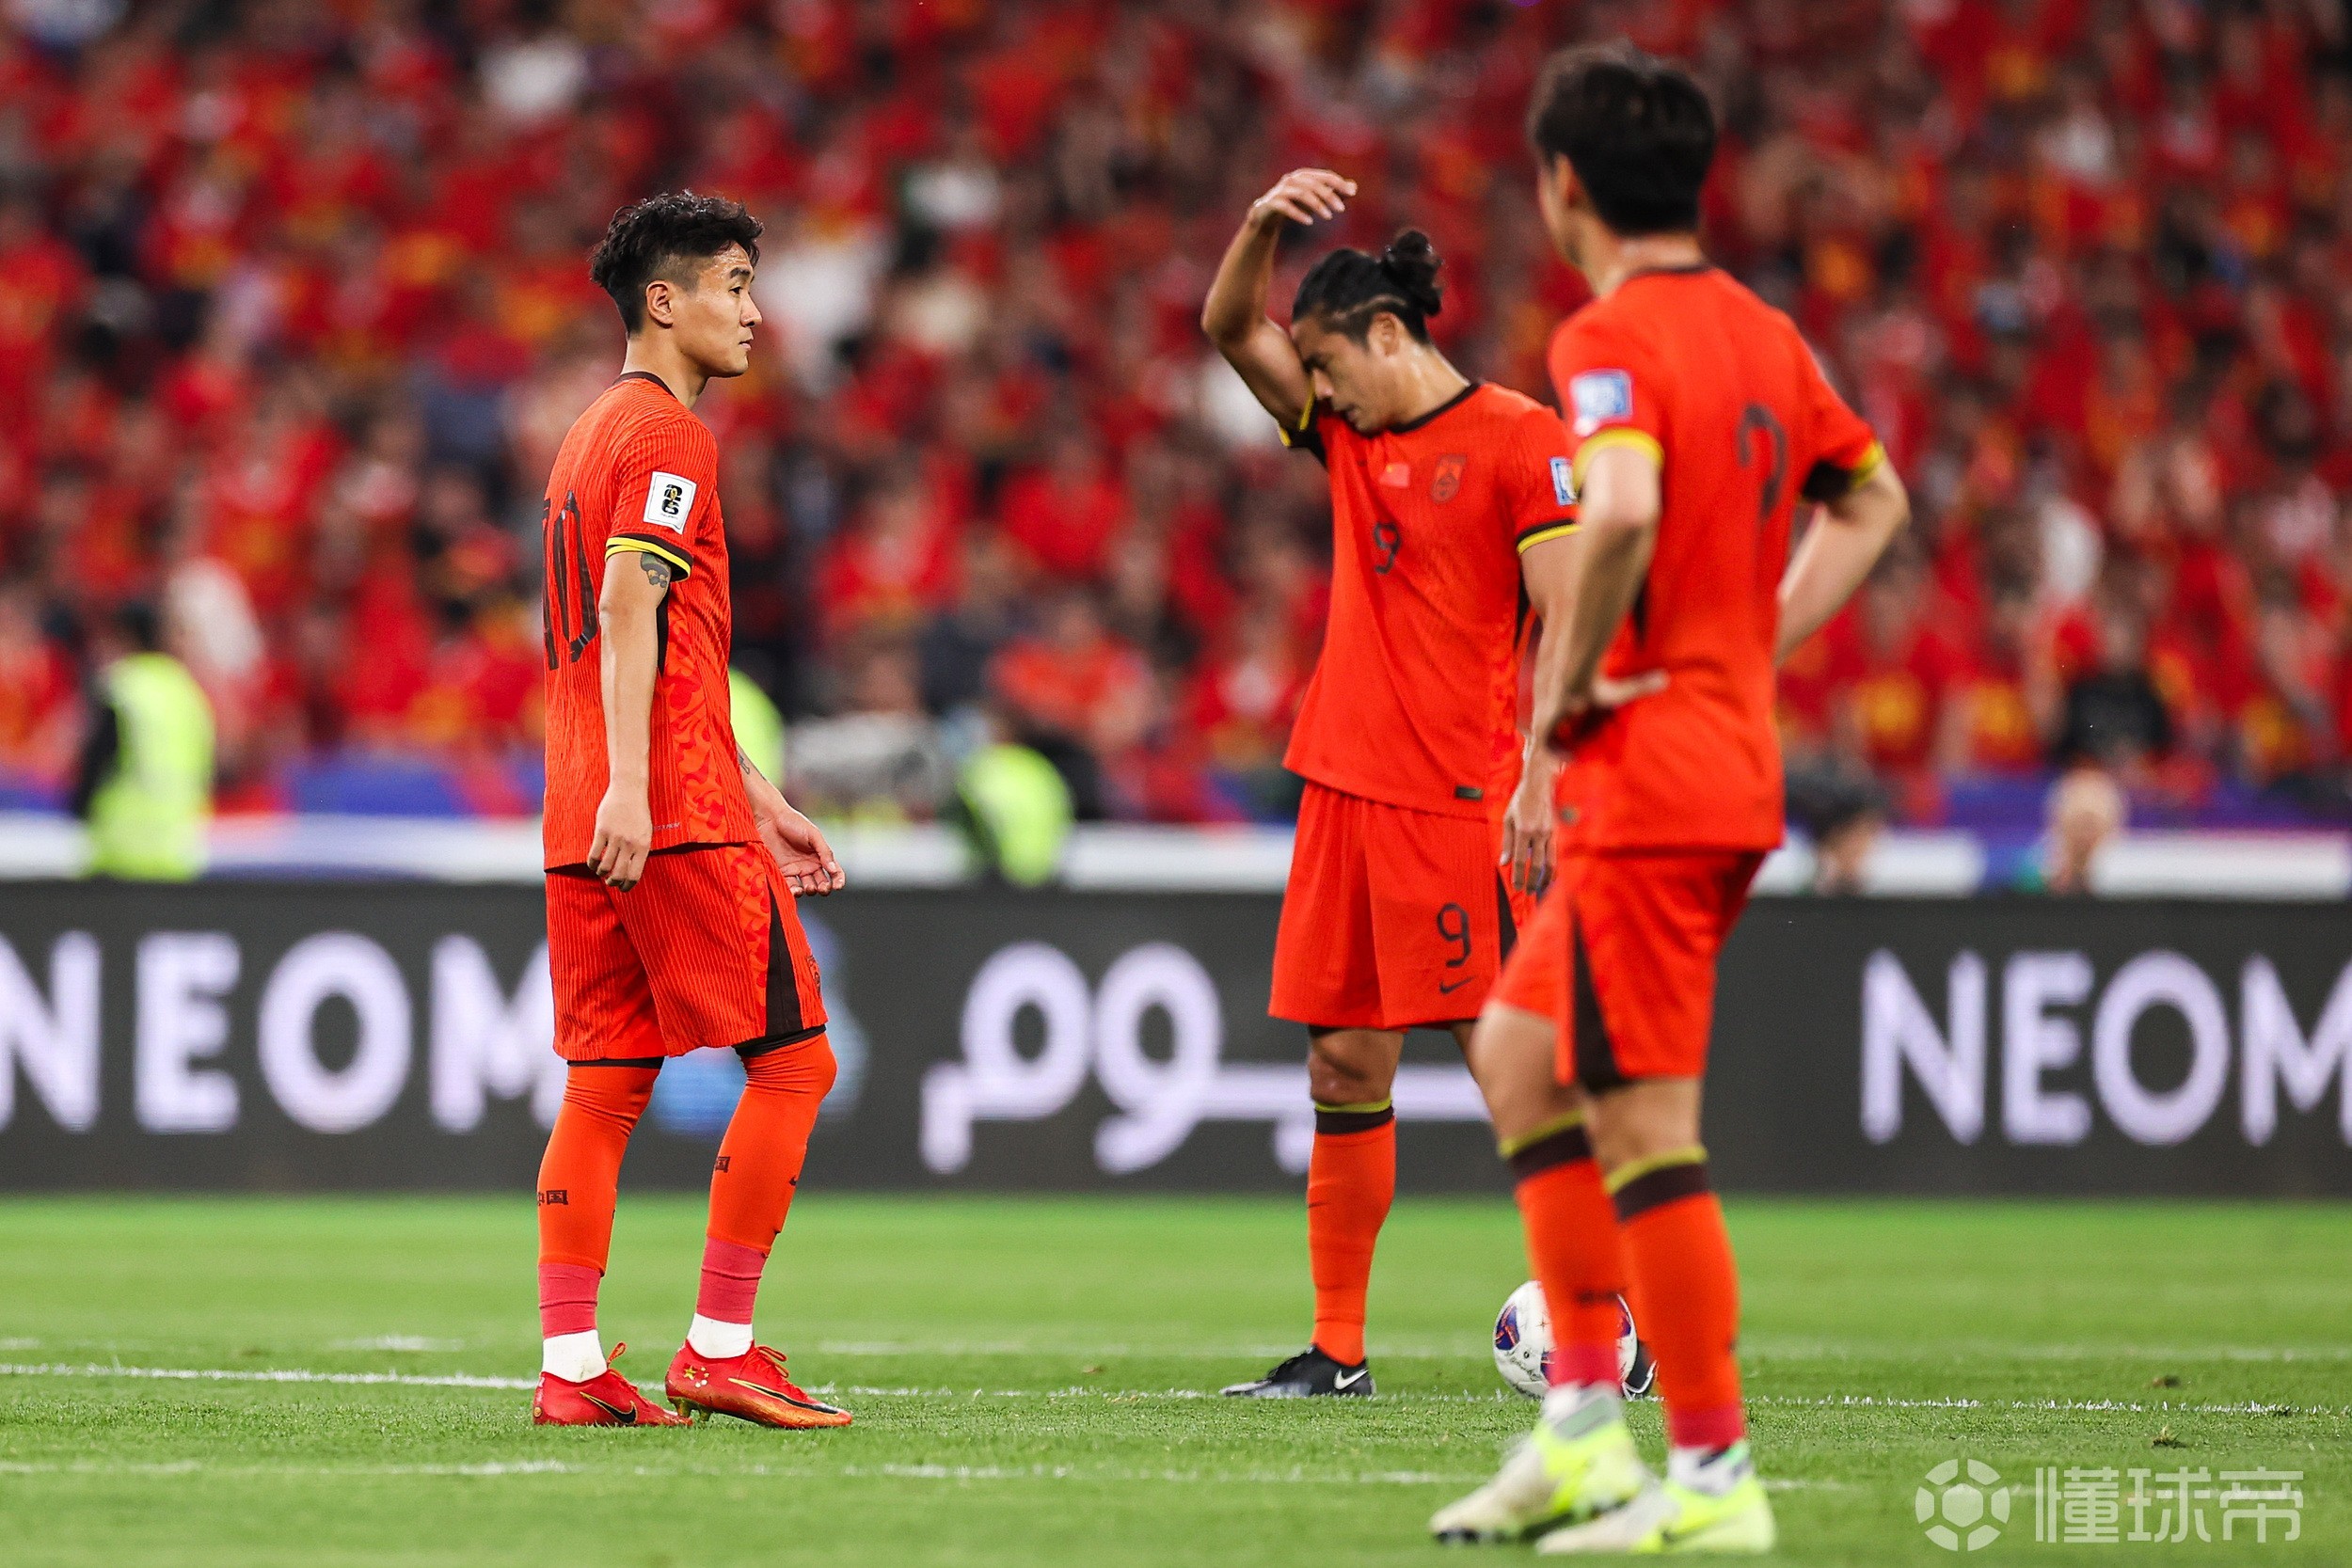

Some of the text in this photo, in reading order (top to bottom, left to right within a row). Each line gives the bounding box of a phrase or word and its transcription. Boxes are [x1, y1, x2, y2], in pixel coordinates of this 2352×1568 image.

[1373, 522, 1401, 575] 9
[1436, 901, 1471, 968] 9
[0, 930, 566, 1133] NEOM
[1861, 948, 2352, 1147] NEOM
